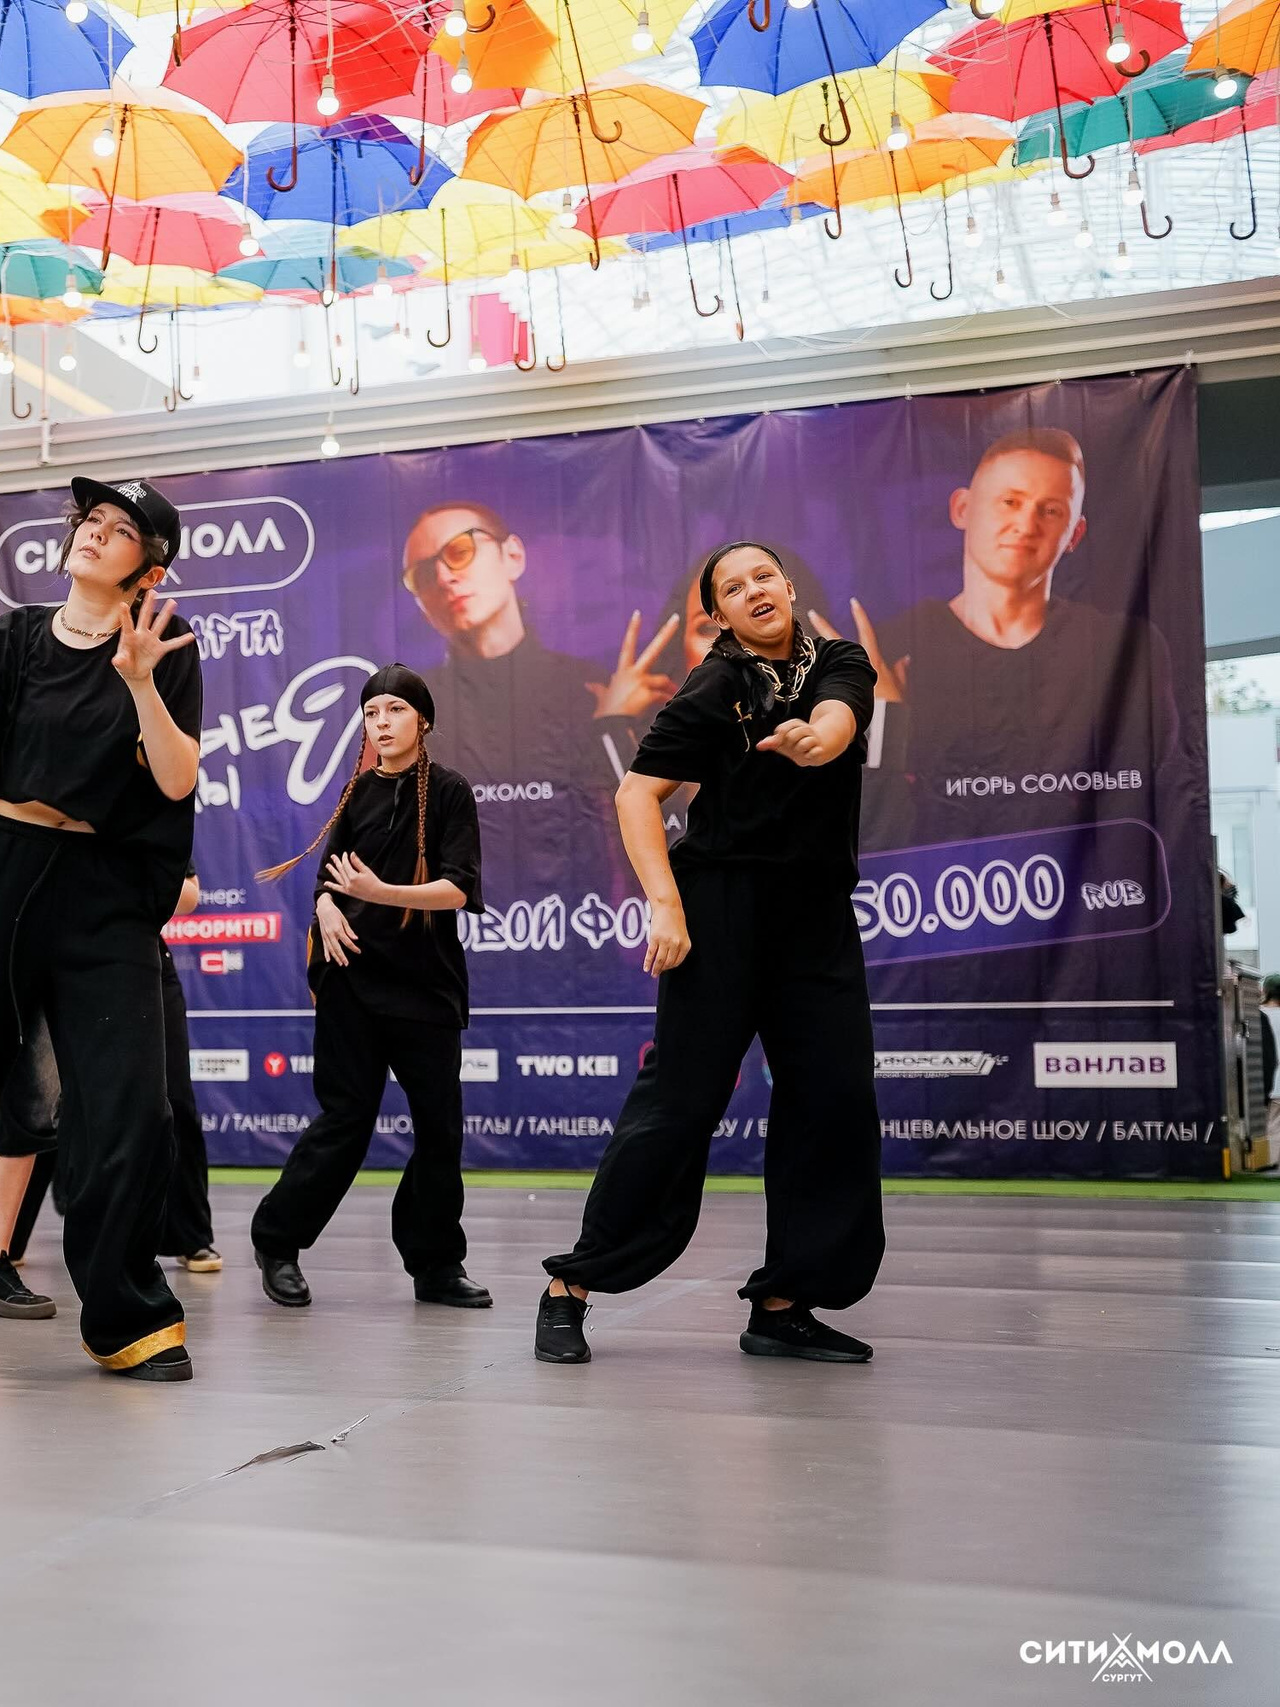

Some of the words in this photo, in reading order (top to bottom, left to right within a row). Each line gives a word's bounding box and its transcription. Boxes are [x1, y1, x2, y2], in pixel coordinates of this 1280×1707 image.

[946, 776, 1016, 797] ИГОРЬ
[1020, 769, 1142, 794] СОЛОВЬЕВ
[1081, 879, 1146, 911] RUB
[570, 892, 651, 950] ФО
[516, 1055, 574, 1077] TWO
[577, 1055, 618, 1077] KEI
[1045, 1055, 1167, 1074] ванлав
[376, 1114, 414, 1134] ШО
[463, 1115, 511, 1135] ТТЛЫ
[1032, 1119, 1090, 1141] ШОУ
[1113, 1120, 1198, 1142] БАТТЛЫ
